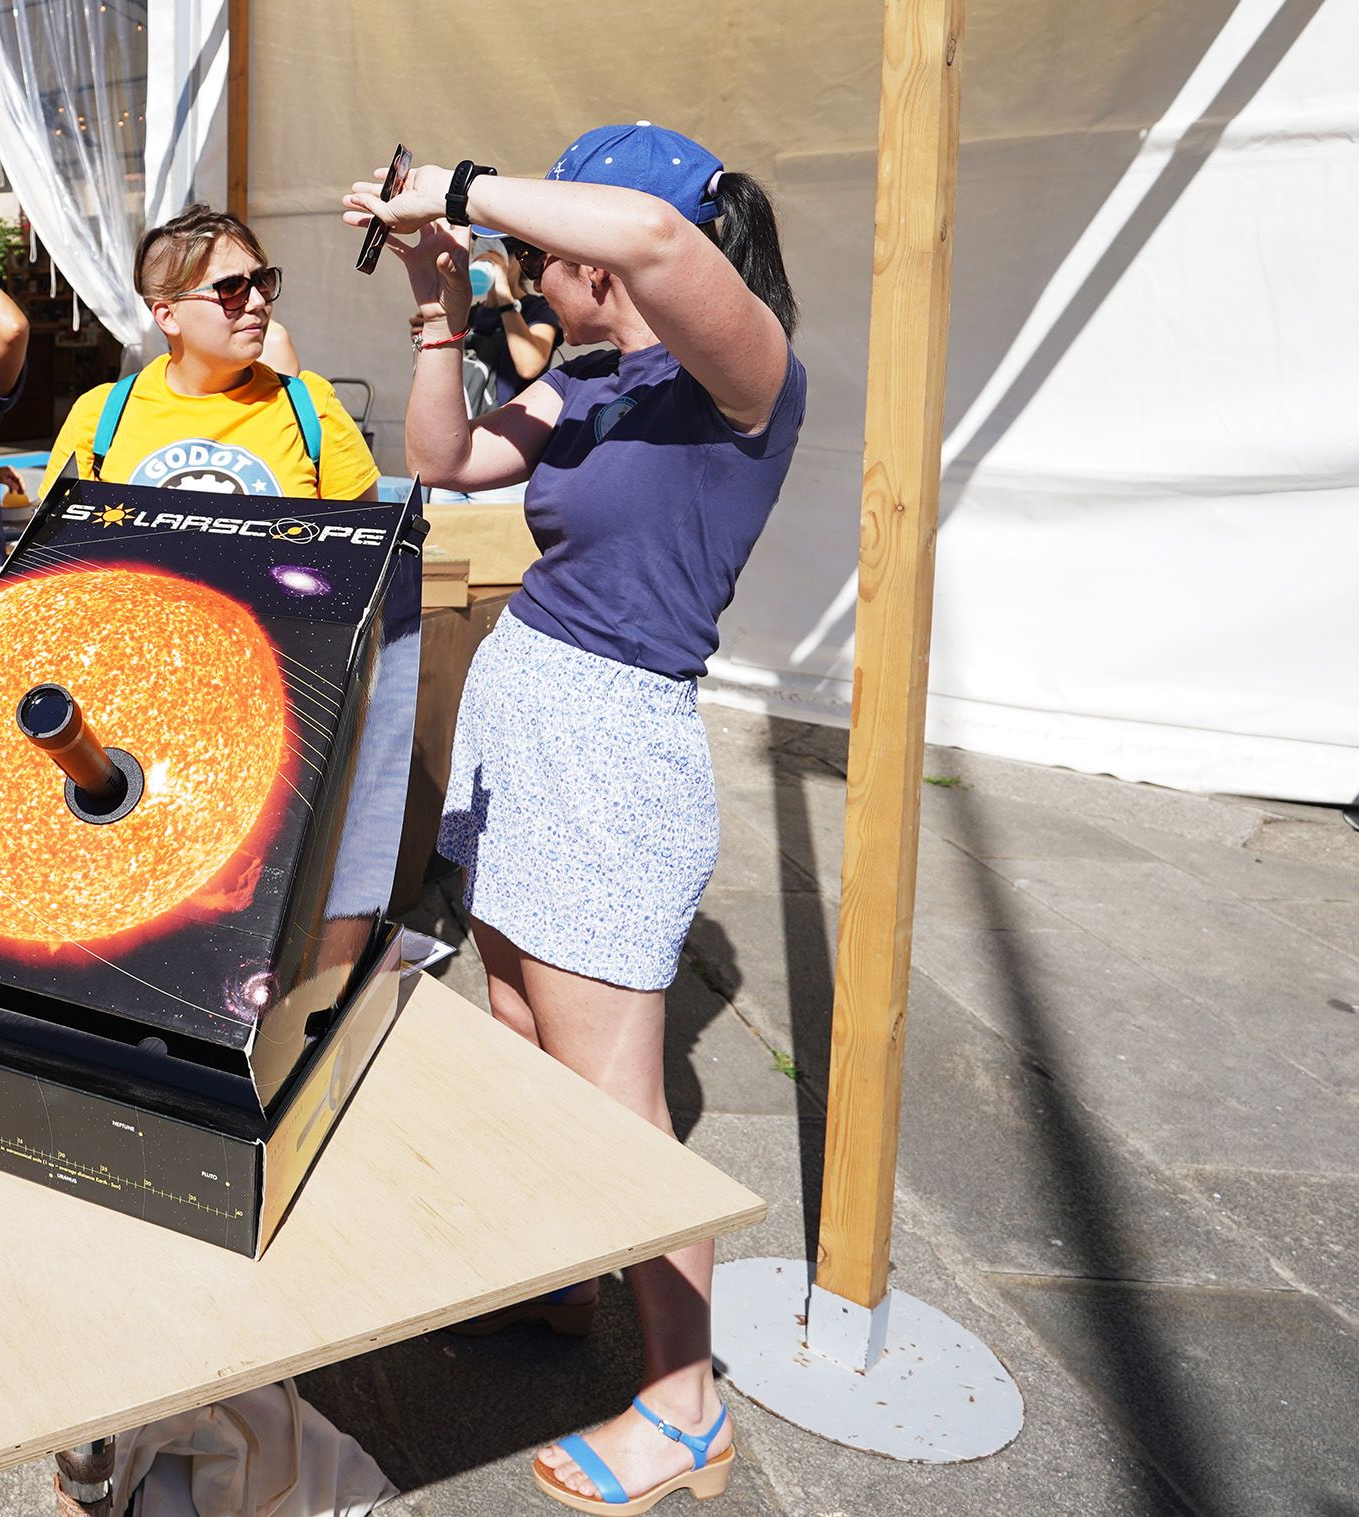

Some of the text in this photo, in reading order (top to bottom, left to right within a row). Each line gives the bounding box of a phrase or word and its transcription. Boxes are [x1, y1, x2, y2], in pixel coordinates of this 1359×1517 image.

[145, 445, 253, 480] GODOT
[112, 1120, 135, 1132] NEPTUNE
[57, 1172, 77, 1184] URANUS
[201, 1170, 218, 1181] PLUTO
